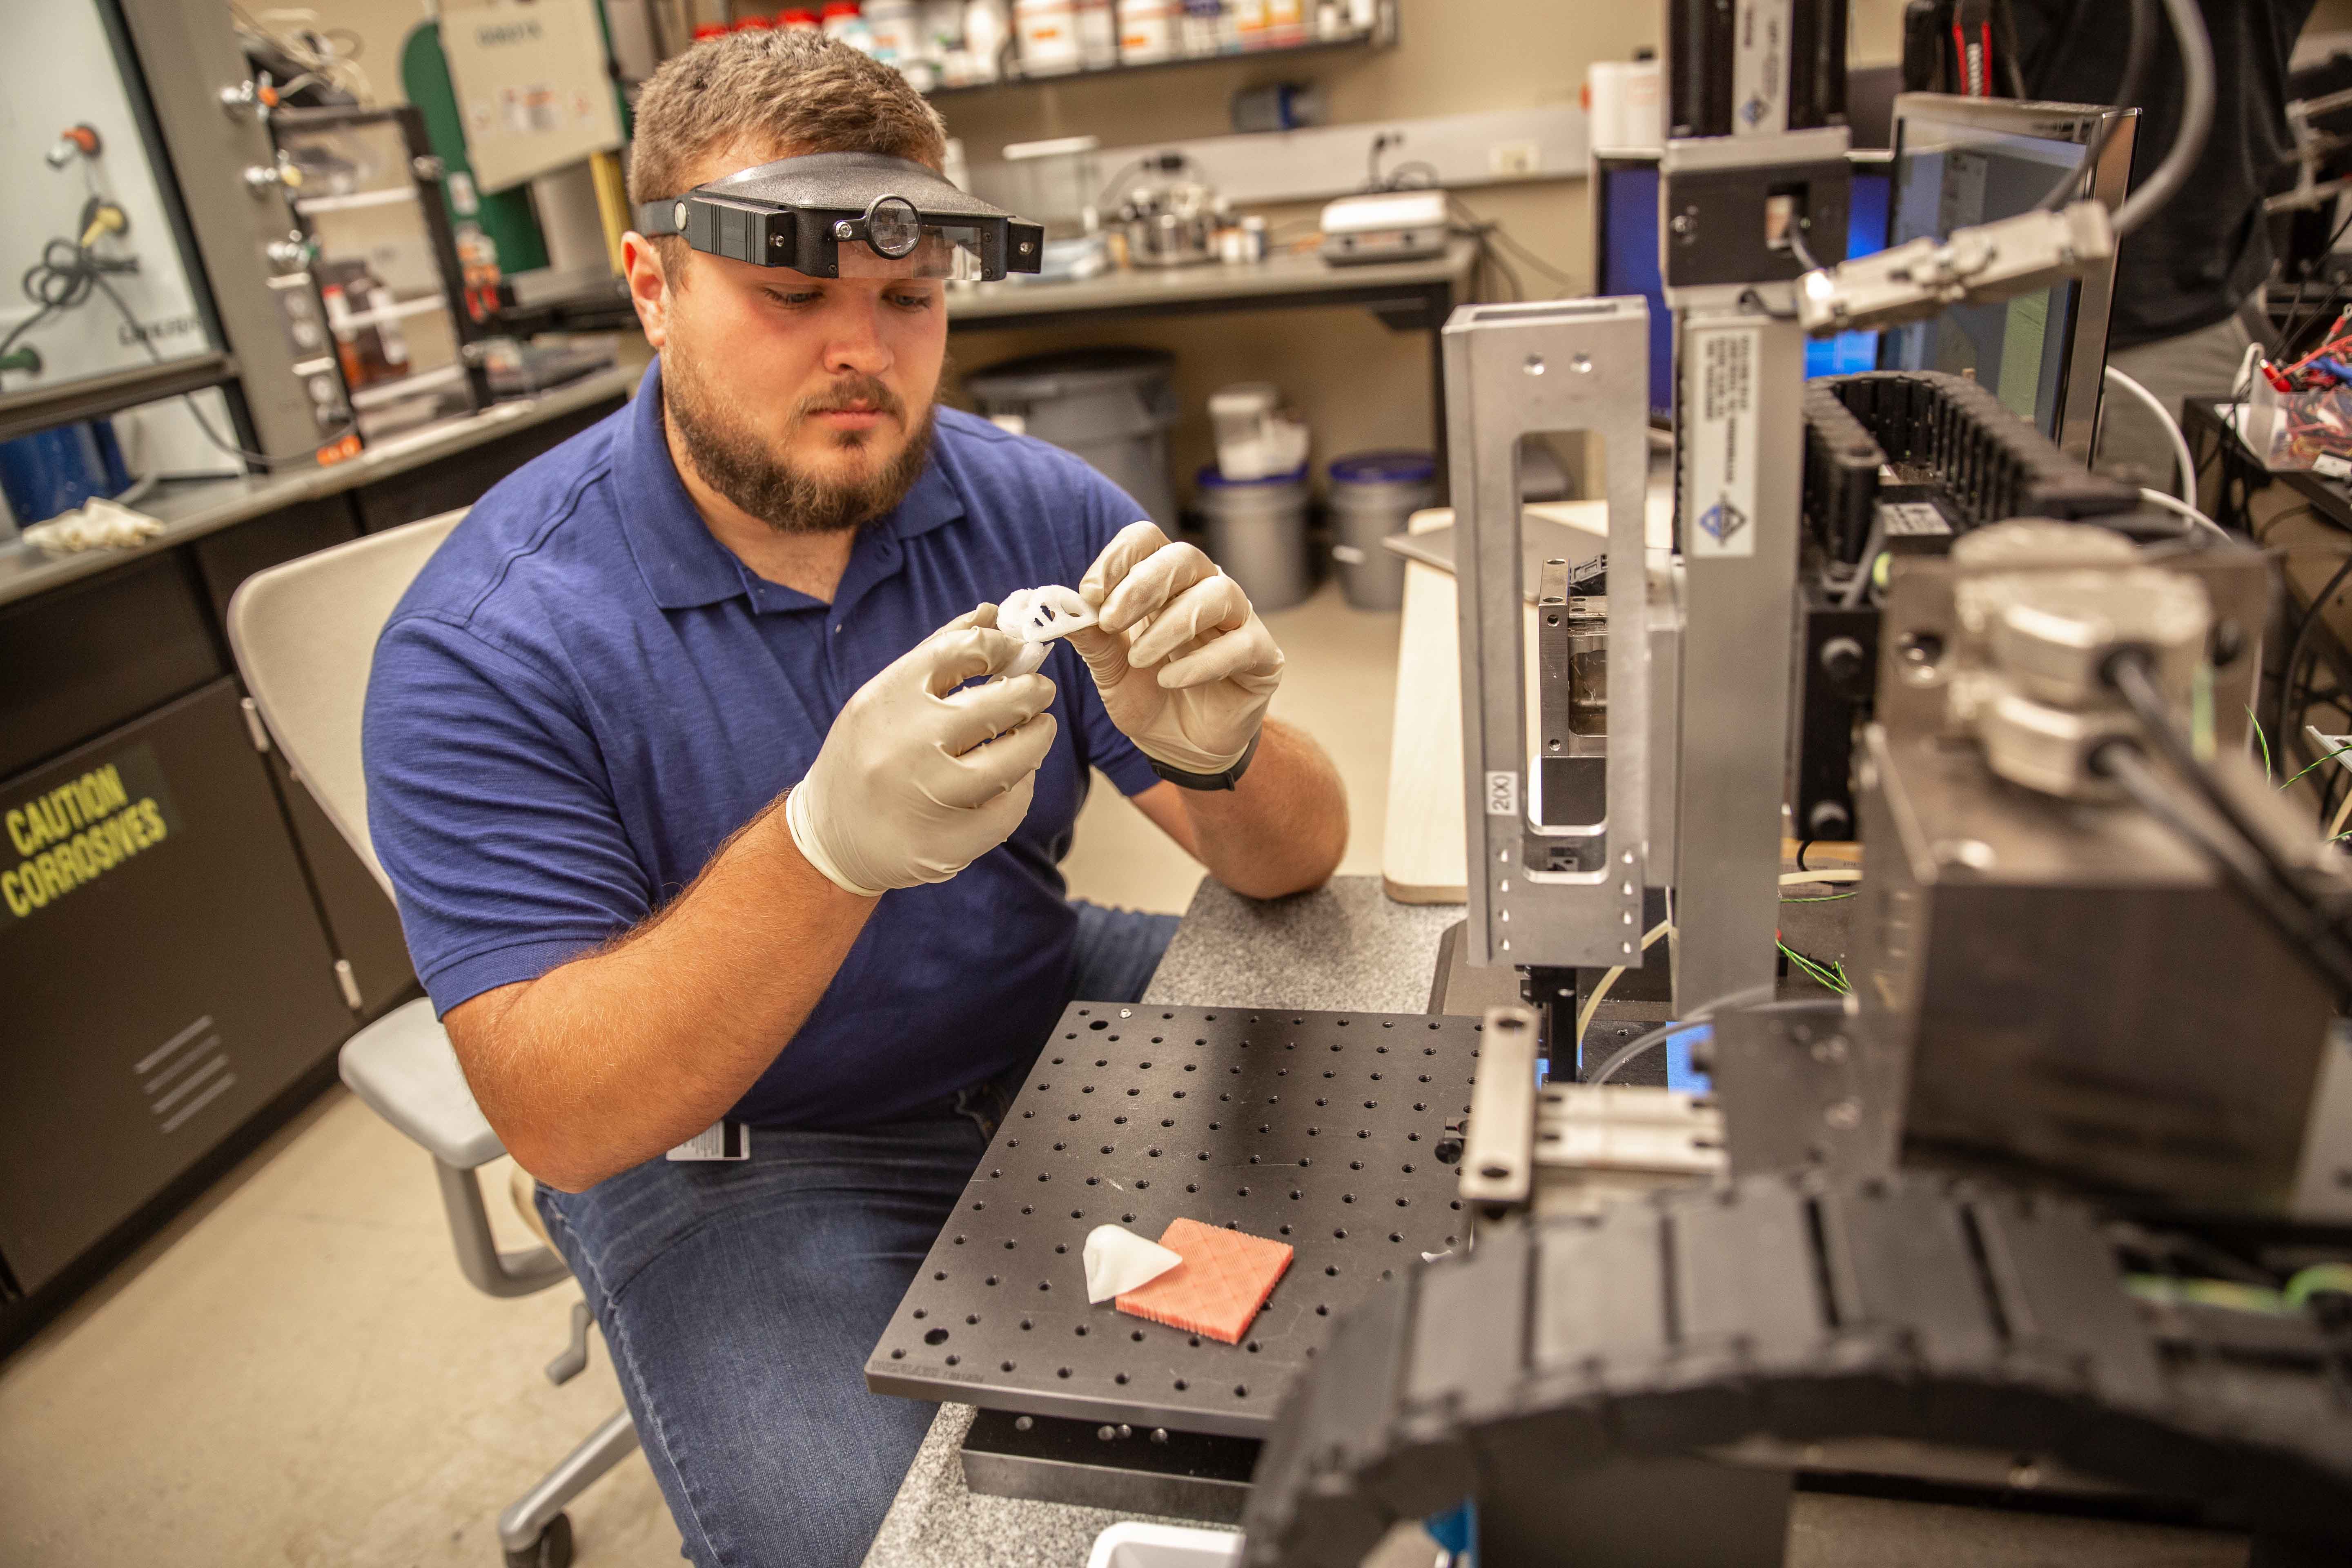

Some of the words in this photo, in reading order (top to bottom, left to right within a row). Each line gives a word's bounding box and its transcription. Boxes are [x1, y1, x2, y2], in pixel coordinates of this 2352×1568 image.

[6, 763, 128, 856] CAUTION
[1492, 775, 1510, 811] 200
[1, 797, 167, 917] CORROSIVES
